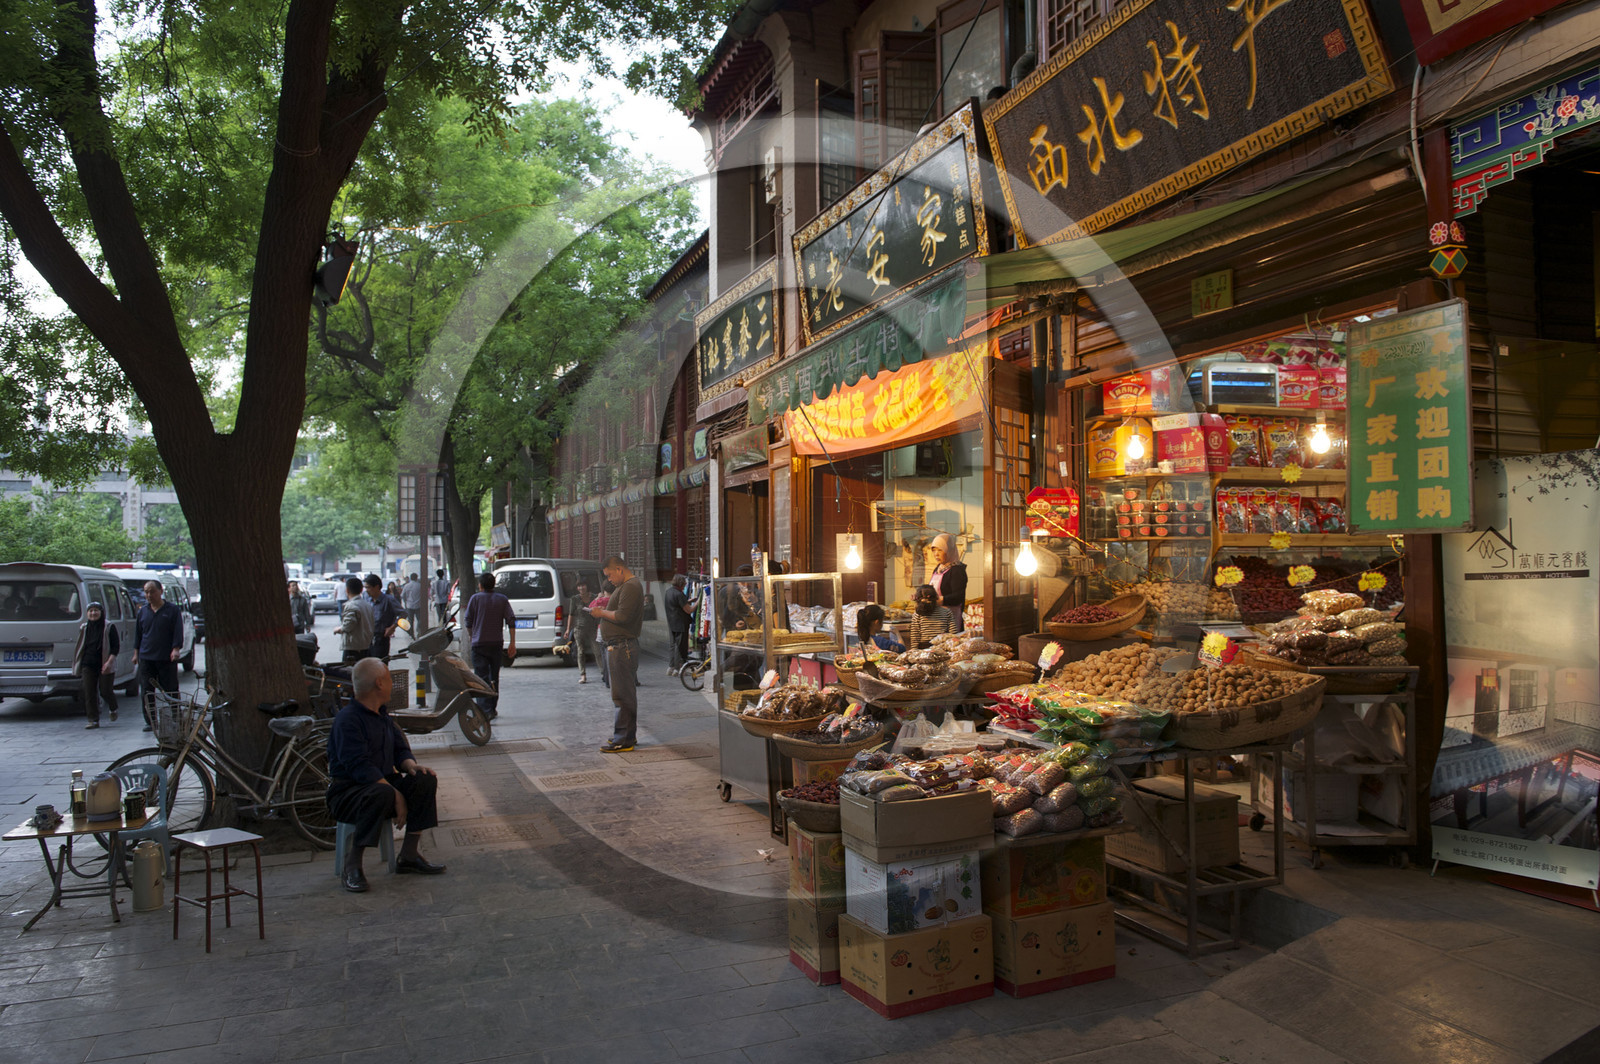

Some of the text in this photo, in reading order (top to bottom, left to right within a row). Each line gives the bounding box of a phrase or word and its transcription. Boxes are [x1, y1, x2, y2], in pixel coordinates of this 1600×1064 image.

[1199, 293, 1222, 313] 147
[1364, 376, 1400, 521] 厂家直销
[1414, 366, 1452, 519] 欢迎团购
[1545, 571, 1572, 579] HOTEL
